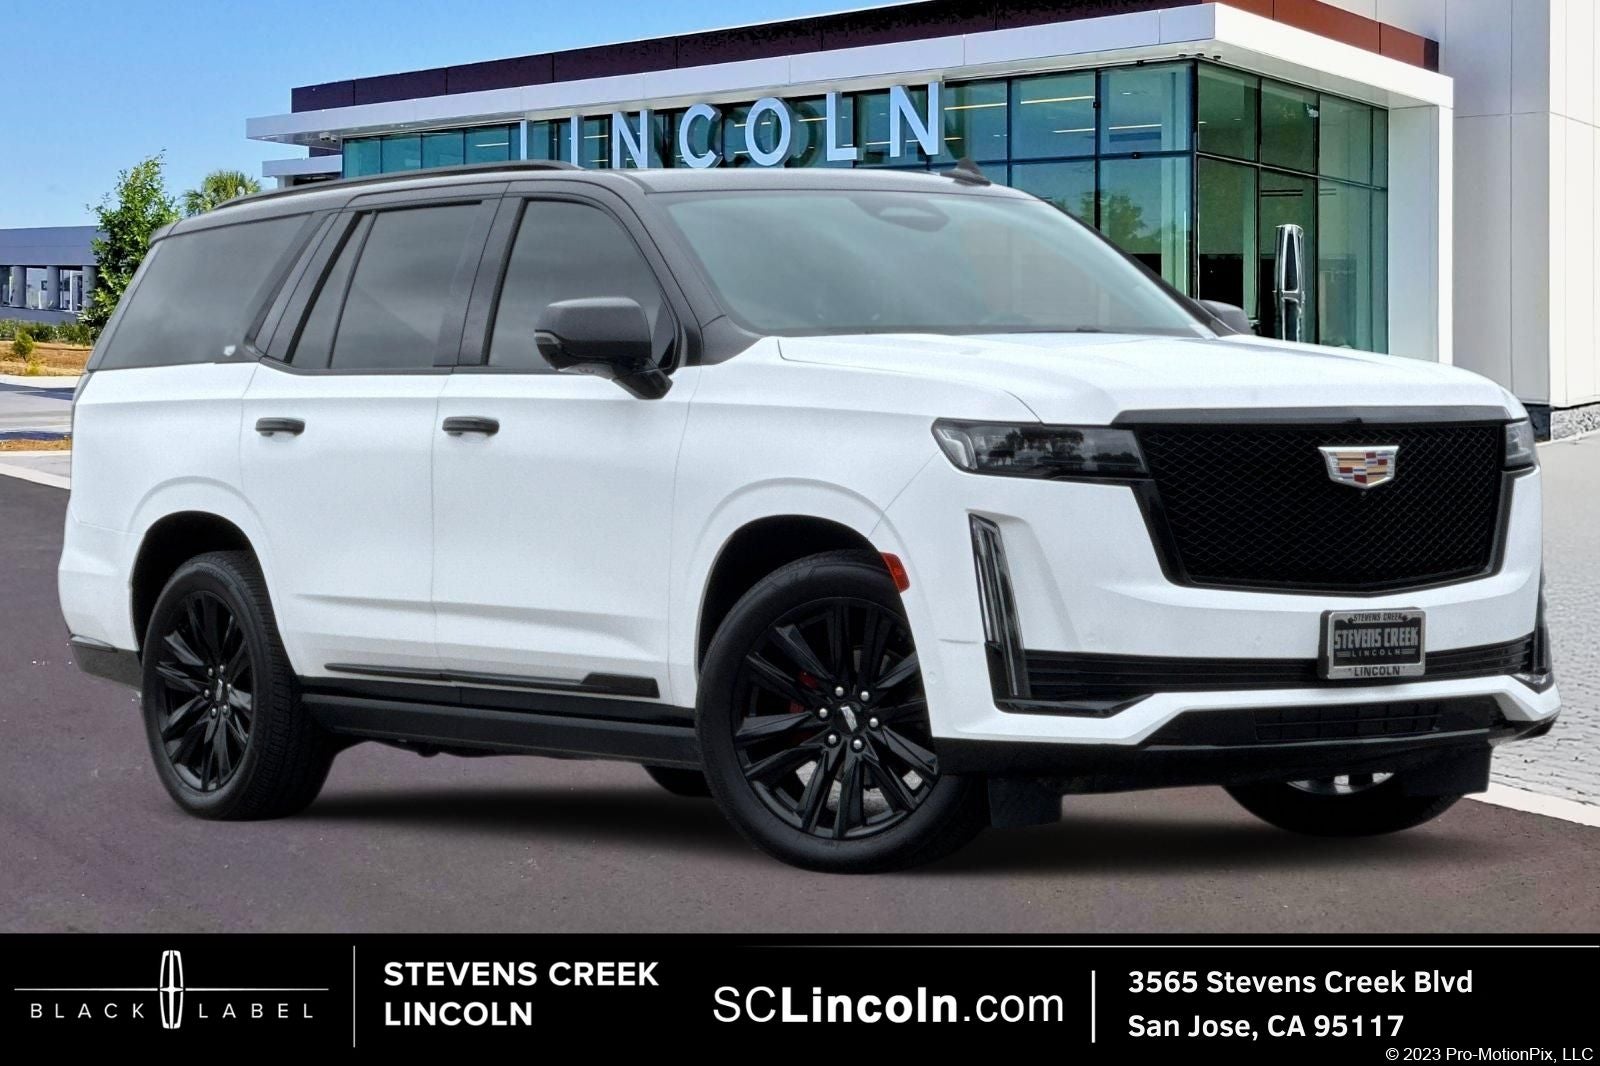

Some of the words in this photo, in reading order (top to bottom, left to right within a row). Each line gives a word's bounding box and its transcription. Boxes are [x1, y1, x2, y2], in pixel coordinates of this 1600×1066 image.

[1353, 613, 1380, 621] STEVENS
[1335, 628, 1381, 649] STEVENS
[1384, 627, 1419, 647] CREEK
[1352, 648, 1400, 657] LINCOLN
[1354, 666, 1400, 677] LINCOLN
